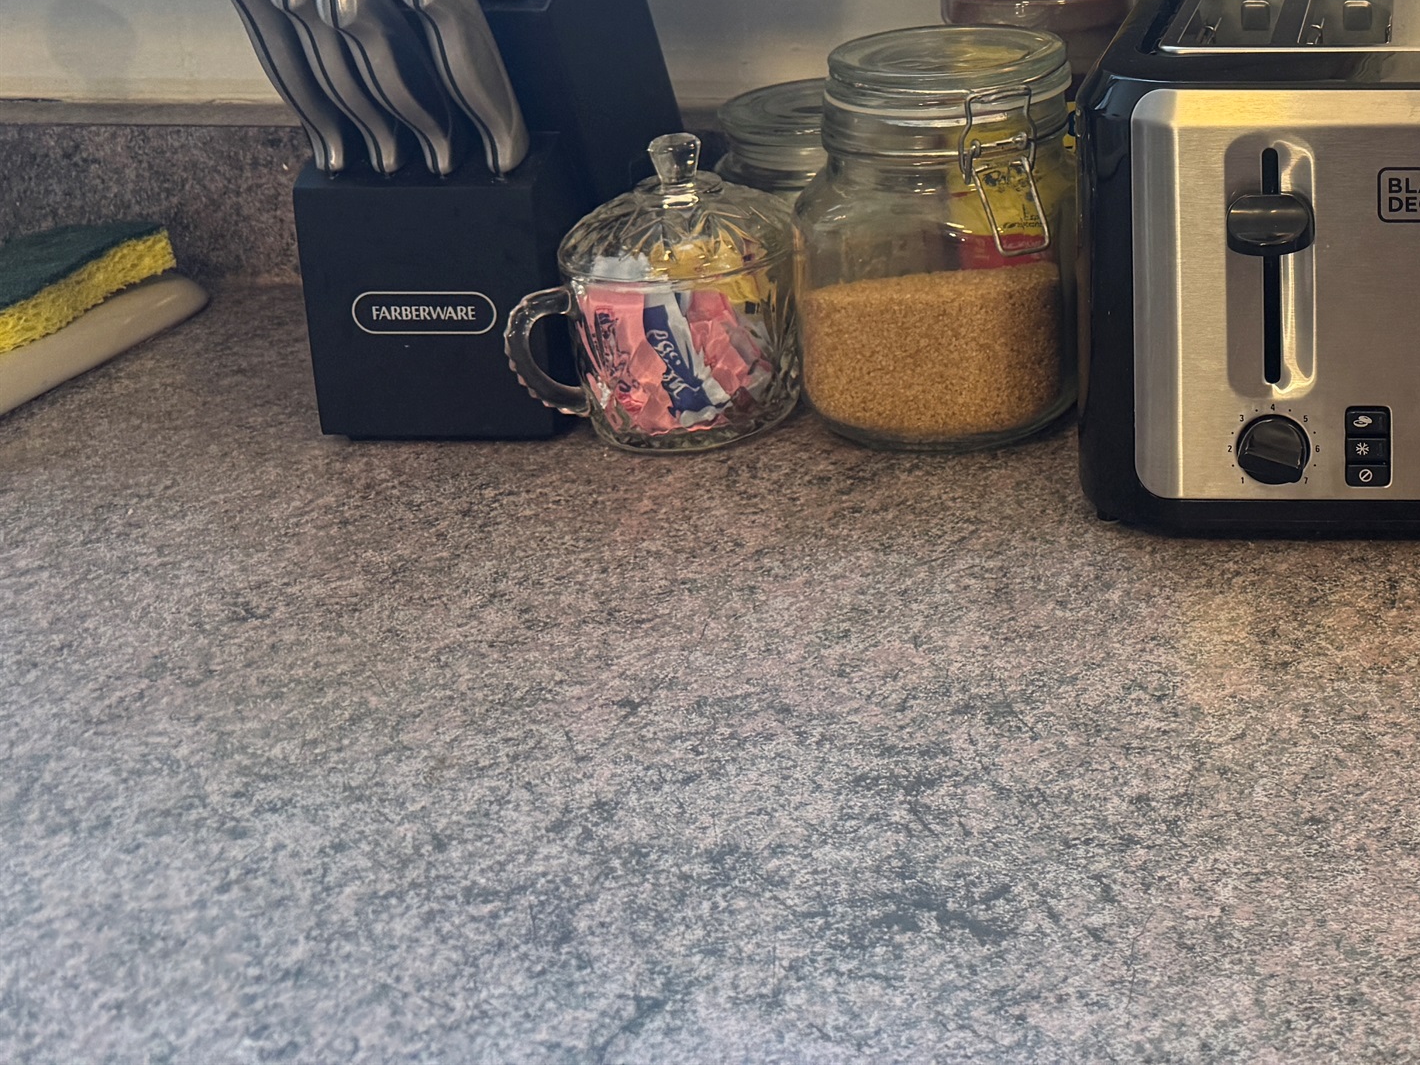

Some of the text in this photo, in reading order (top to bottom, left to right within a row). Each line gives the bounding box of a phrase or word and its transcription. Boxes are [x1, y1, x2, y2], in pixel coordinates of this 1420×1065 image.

[371, 305, 476, 321] FARBERWARE
[1270, 403, 1276, 411] 4
[1239, 414, 1245, 422] 3
[1241, 476, 1245, 484] 1
[1304, 476, 1309, 484] 7
